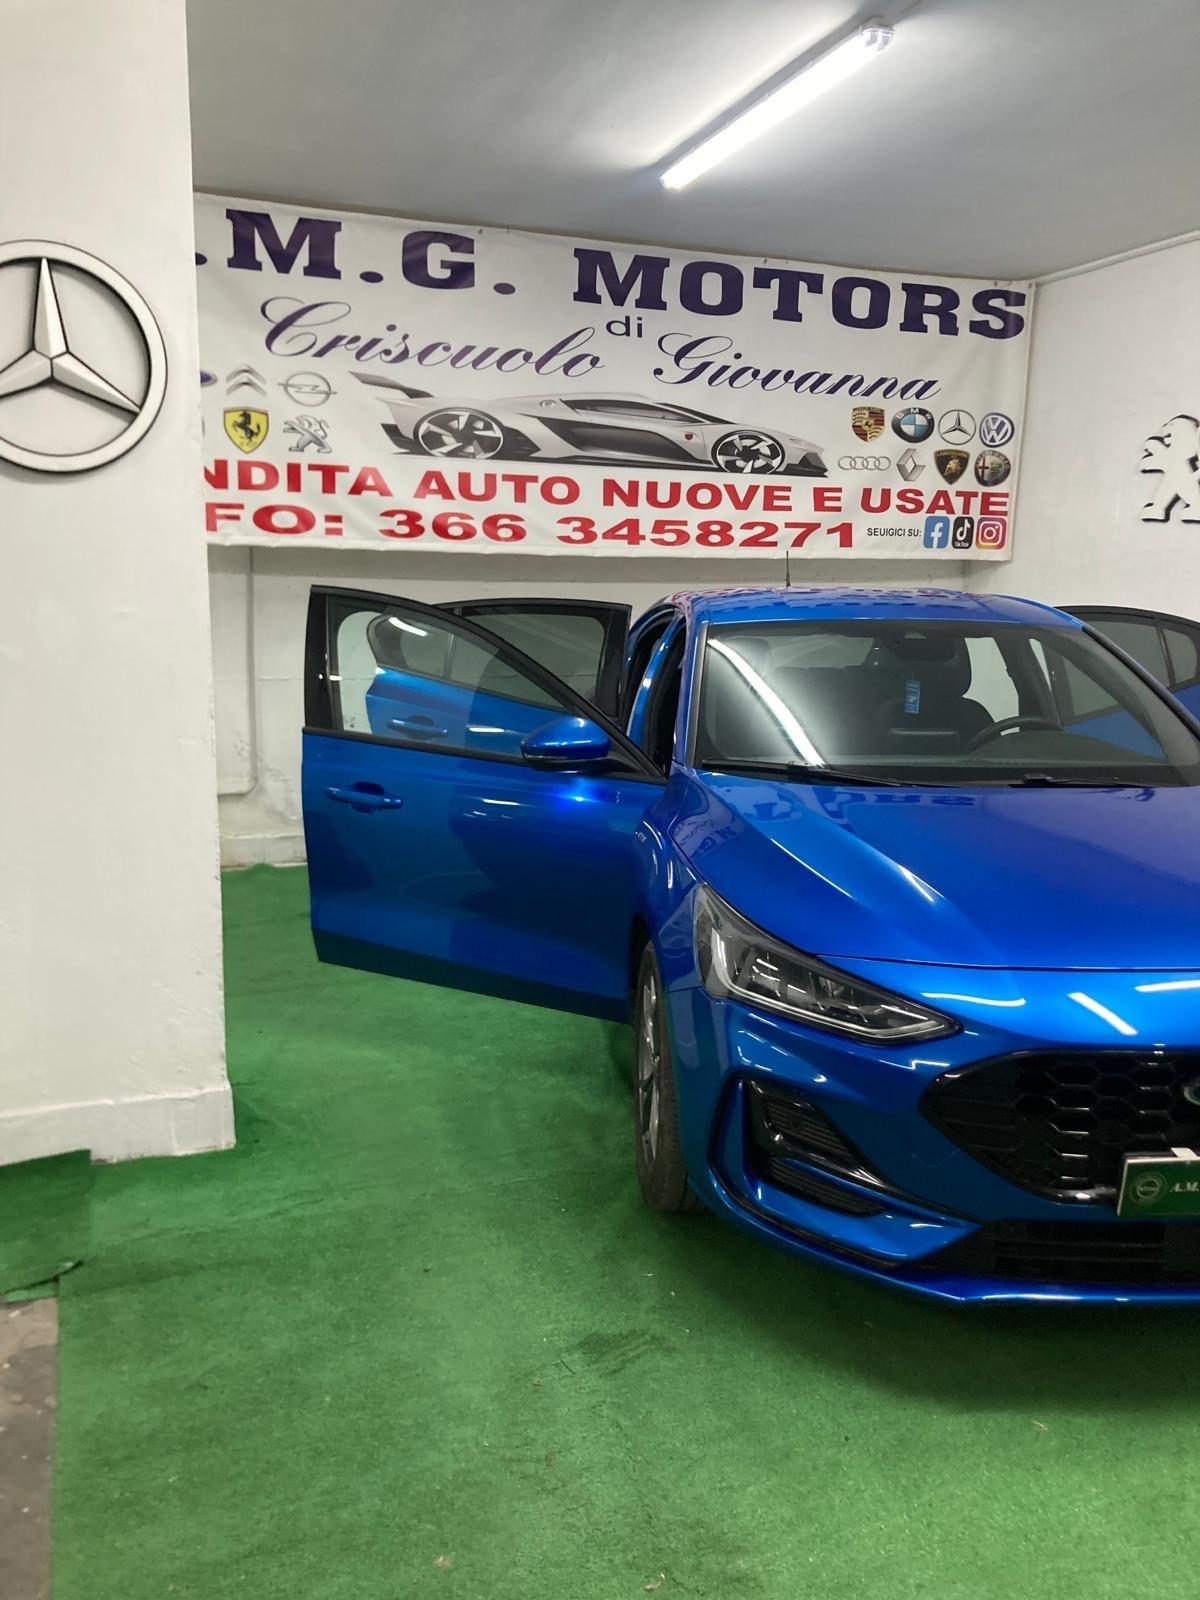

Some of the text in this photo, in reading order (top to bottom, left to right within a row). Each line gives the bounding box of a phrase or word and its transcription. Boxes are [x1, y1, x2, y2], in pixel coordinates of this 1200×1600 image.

[573, 247, 1027, 340] MOTORS
[259, 296, 942, 401] Criscuolo Giovanna
[605, 315, 644, 339] di
[413, 470, 581, 506] AUTO
[602, 478, 793, 513] NUOVE
[812, 486, 843, 513] E
[859, 487, 1010, 517] USATE
[381, 508, 528, 543] 366
[557, 515, 854, 549] 3458271
[867, 526, 922, 537] SEUIGICI SU:
